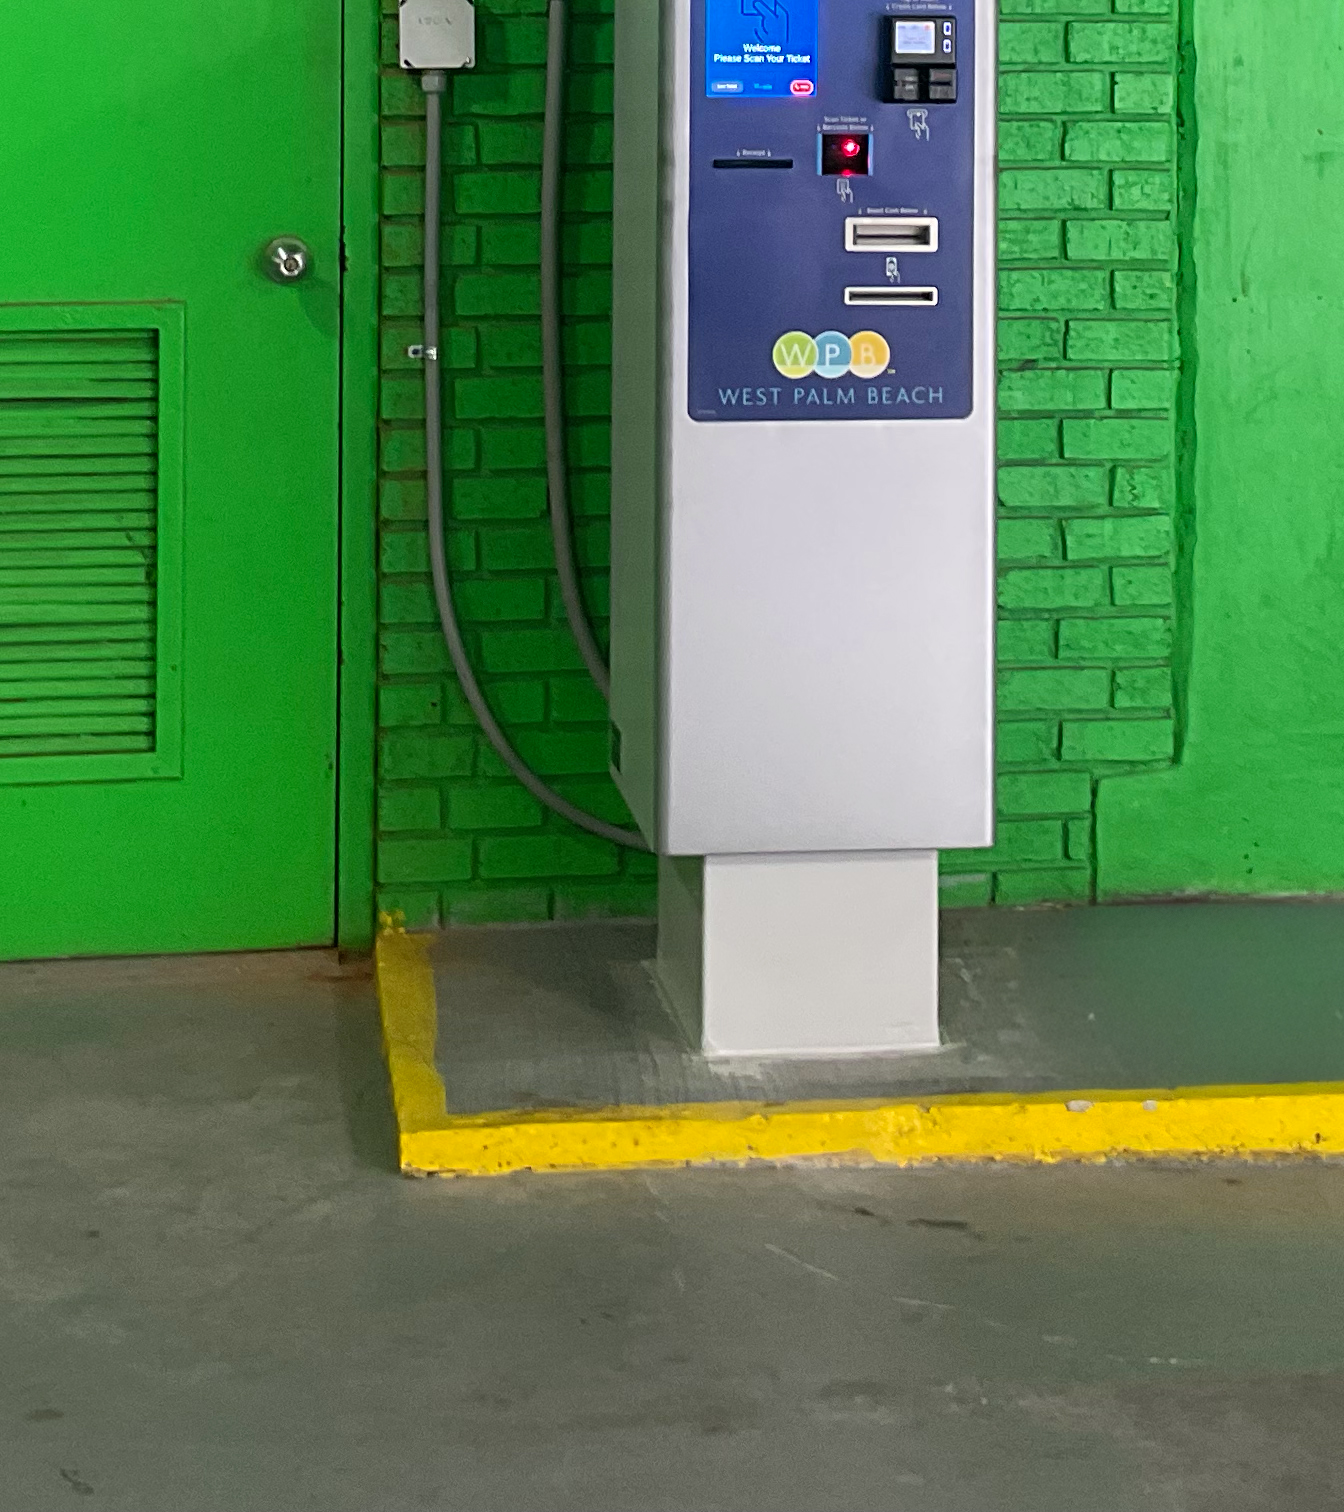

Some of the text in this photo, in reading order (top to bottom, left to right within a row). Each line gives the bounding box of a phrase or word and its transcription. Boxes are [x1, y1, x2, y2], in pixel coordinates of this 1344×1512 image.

[742, 43, 782, 53] Welcome
[713, 53, 811, 64] Please Scan Your Ticket
[718, 386, 944, 406] WEST PALM BEACH
